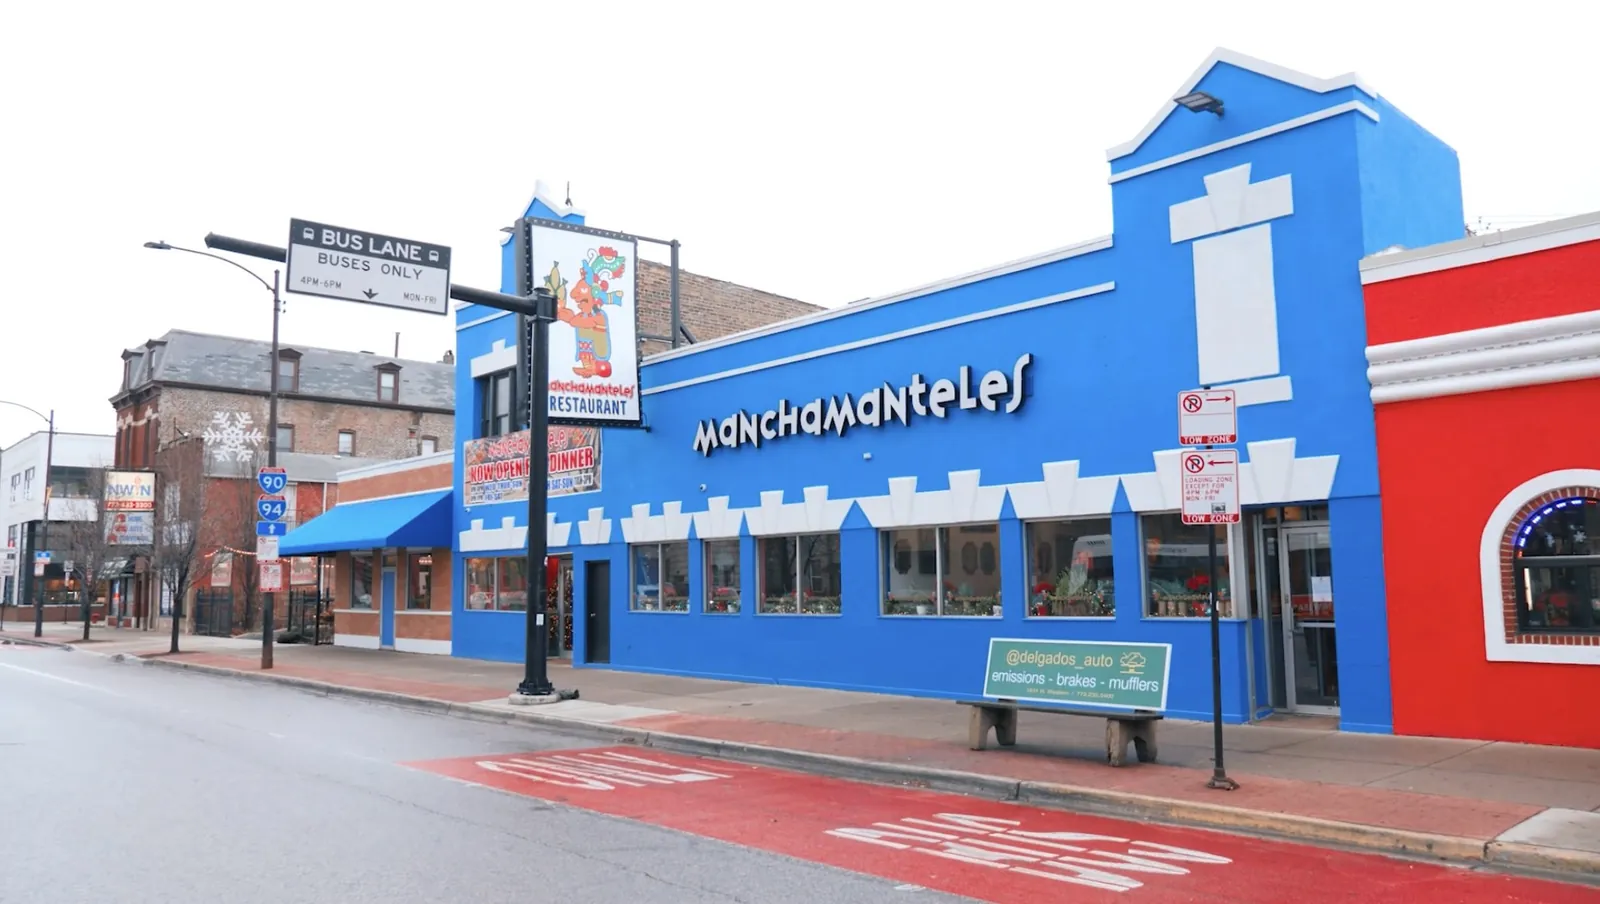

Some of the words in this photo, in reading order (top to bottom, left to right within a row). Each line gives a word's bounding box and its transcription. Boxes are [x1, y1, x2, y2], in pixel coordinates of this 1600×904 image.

[322, 229, 363, 251] BUS
[369, 237, 422, 261] LANE
[318, 252, 371, 272] BUSES
[381, 263, 423, 280] ONLY
[300, 276, 342, 289] 4PM-6PM
[403, 292, 437, 305] MON-FRI
[549, 395, 627, 415] RESTAURANT
[1184, 436, 1203, 444] TOW
[1208, 435, 1231, 443] ZONE
[470, 464, 494, 482] NOW
[496, 459, 523, 480] OPEN
[549, 447, 594, 473] DINNER
[263, 475, 283, 489] 90
[262, 503, 282, 516] 94
[1210, 514, 1234, 522] ZONE
[1006, 649, 1113, 669] @delgados_auto
[992, 670, 1045, 685] emissions
[1056, 673, 1096, 688] brakes
[1108, 676, 1159, 692] mufflers
[823, 813, 1234, 892] BUS
